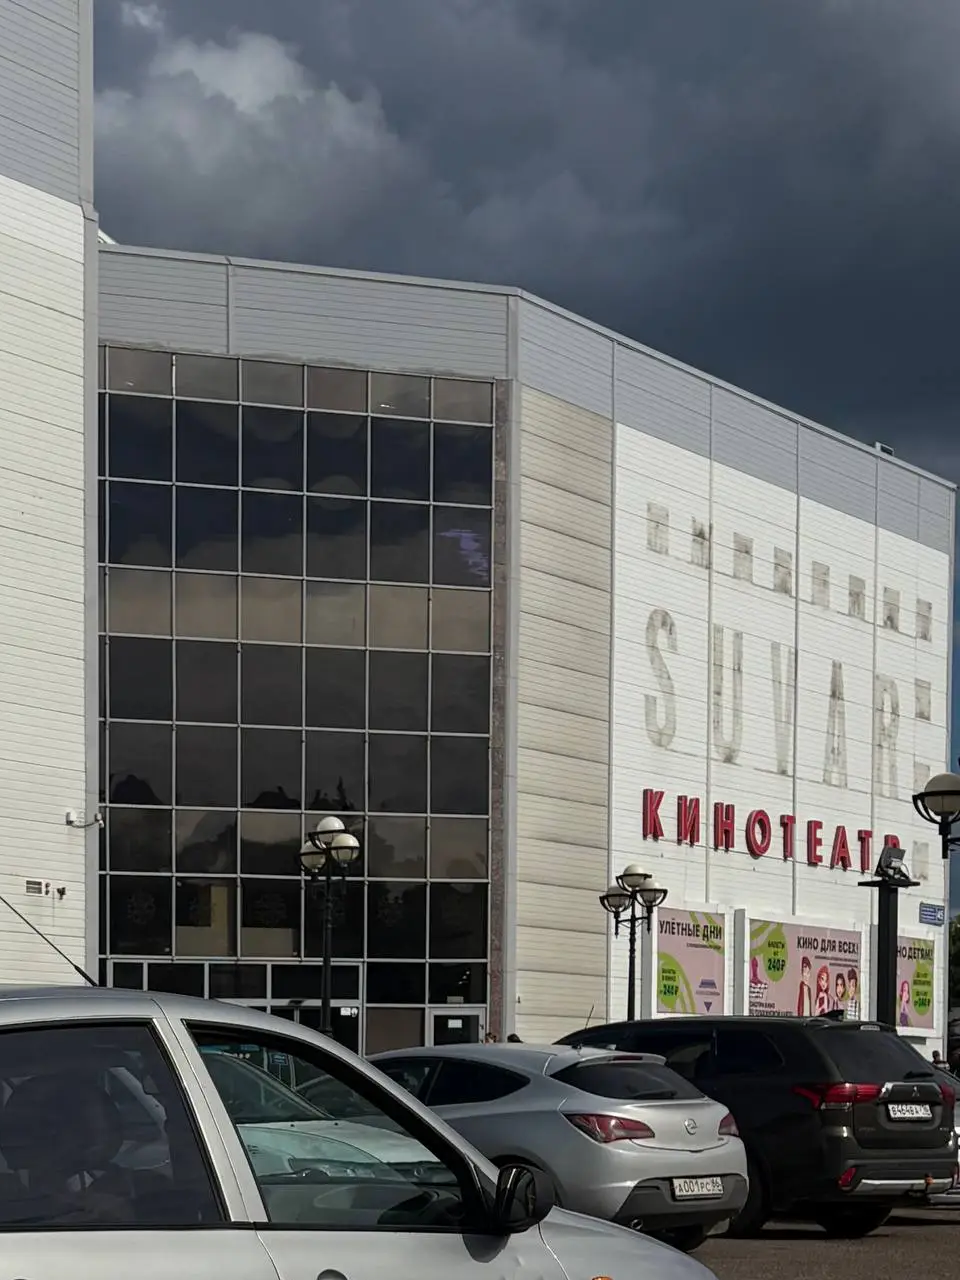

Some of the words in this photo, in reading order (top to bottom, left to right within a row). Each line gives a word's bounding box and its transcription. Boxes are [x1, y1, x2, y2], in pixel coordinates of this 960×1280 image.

[659, 917, 700, 938] УЛЁТНЫЕ
[702, 924, 722, 941] ДНИ
[797, 936, 819, 950] КИНО
[820, 939, 837, 953] ДЛЯ
[838, 940, 859, 955] ВСЕХ!
